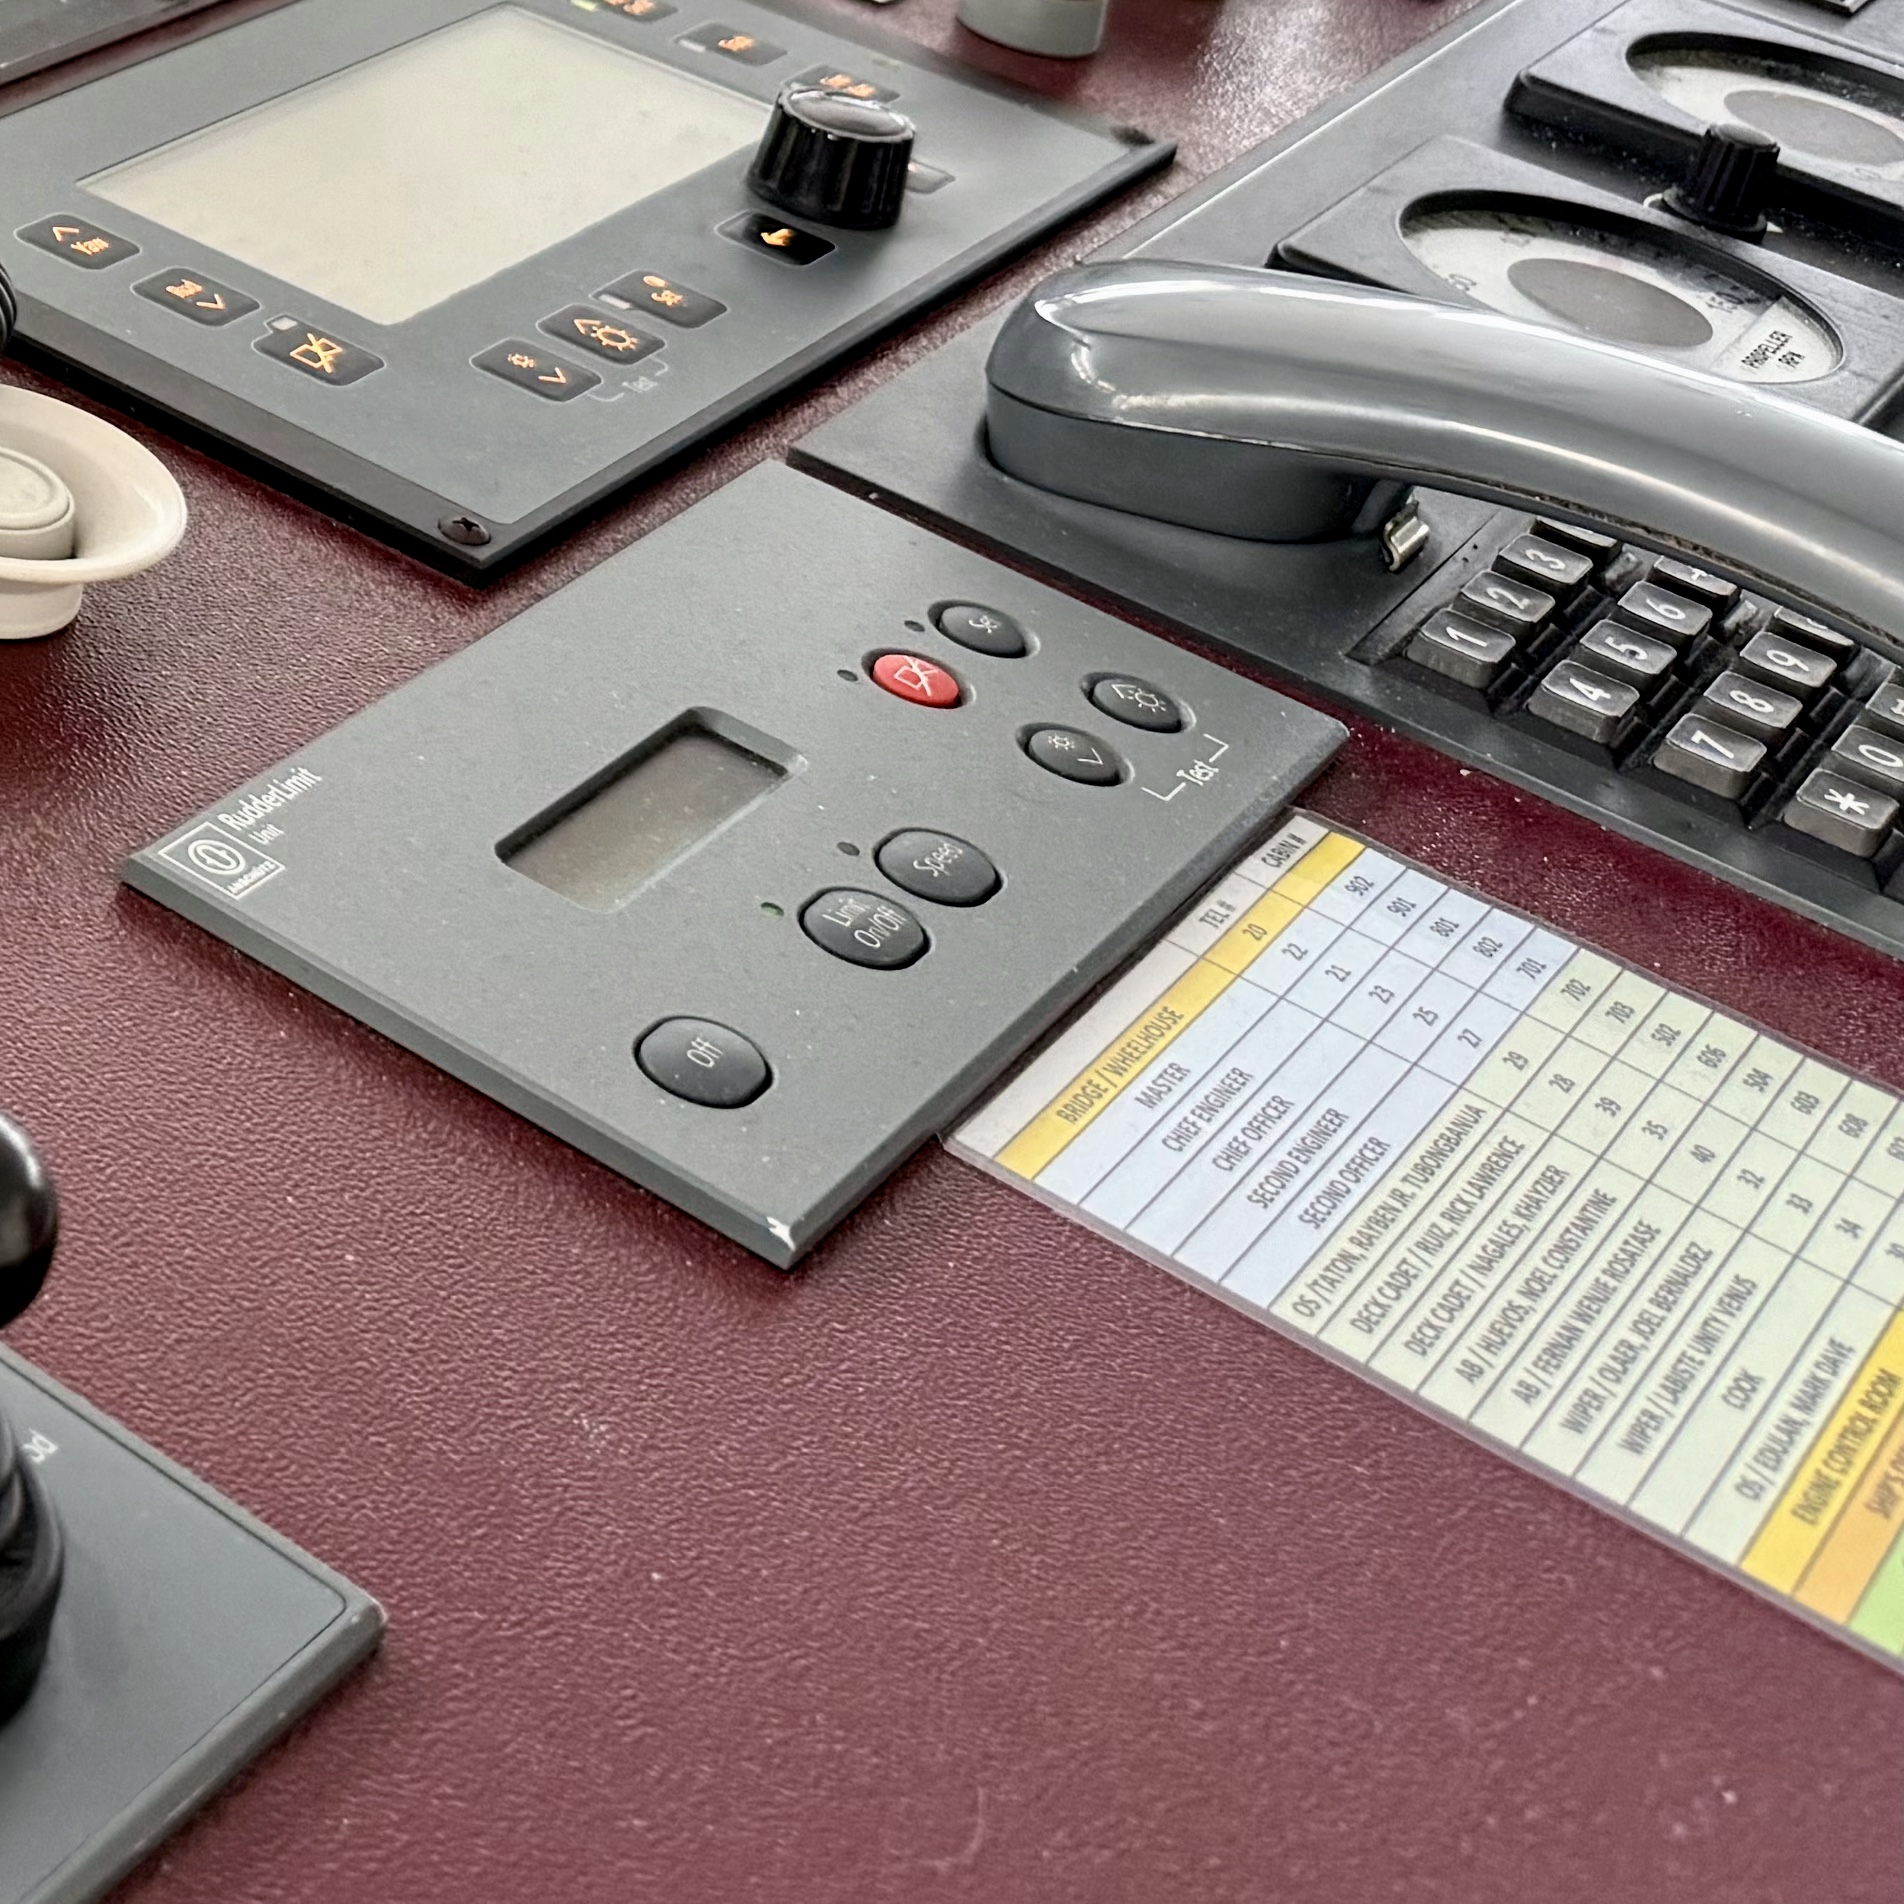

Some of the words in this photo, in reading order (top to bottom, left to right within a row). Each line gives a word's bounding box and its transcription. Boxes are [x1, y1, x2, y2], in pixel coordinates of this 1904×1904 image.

[1531, 547, 1567, 572] 3
[1485, 586, 1530, 611] 2
[1657, 598, 1687, 620] 6
[1445, 625, 1489, 647] 1
[1617, 637, 1649, 661] 5
[1767, 648, 1811, 672] 9
[1568, 676, 1612, 702] 4
[1729, 689, 1773, 714] 8
[1692, 730, 1736, 759] 7
[1857, 743, 1903, 767] 0
[1177, 760, 1219, 790] Test
[217, 779, 286, 831] Rudder
[249, 823, 284, 846] Unit
[928, 839, 966, 879] Speed
[1200, 907, 1225, 930] TEL
[1261, 839, 1296, 870] CABIN
[853, 905, 908, 952] On/Off
[1134, 1061, 1192, 1110] MASTER
[1282, 942, 1311, 962] 22
[1344, 874, 1376, 897] 902
[1558, 977, 1593, 1004] 702
[1056, 1070, 1100, 1126] BRIDGE
[1103, 1006, 1186, 1078] WHEELHOUSE
[1242, 923, 1269, 943] 20
[1160, 1109, 1204, 1154] CHIEF
[1195, 1066, 1256, 1121] ENGINEER
[1324, 963, 1352, 984] 21
[1386, 896, 1418, 918] 901
[1212, 1127, 1254, 1174] CHIEF
[1244, 1093, 1296, 1140] OFFICER
[1368, 984, 1397, 1006] 23
[1428, 917, 1461, 941] 801
[687, 1037, 724, 1069] Off
[1245, 1158, 1296, 1211] SECOND
[1289, 1106, 1351, 1168] ENGINEER
[1412, 1006, 1440, 1028] 25
[1470, 934, 1505, 960] 802
[1502, 1050, 1530, 1073] 29
[1296, 1179, 1347, 1232] SECOND
[1339, 1134, 1392, 1189] OFFICER
[1455, 1027, 1486, 1050] 27
[1514, 956, 1549, 981] 701
[1349, 1295, 1389, 1336] DECK
[1377, 1256, 1424, 1308] CADET
[1443, 1193, 1478, 1237] RICK
[1464, 1135, 1526, 1204] LAWRENCE
[1548, 1071, 1577, 1096] 28
[1604, 999, 1637, 1026] 703
[1401, 1104, 1487, 1197] TUBONGBANUA
[1389, 1180, 1416, 1214] JR.
[1404, 1318, 1442, 1359] DECK
[1430, 1283, 1473, 1329] CADET
[1594, 1096, 1623, 1120] 39
[1649, 1022, 1682, 1048] 502
[1350, 1199, 1397, 1253] RAYBEN
[1509, 1376, 1542, 1409] AB
[1536, 1314, 1586, 1377] FERNAN
[1688, 1142, 1718, 1167] 40
[1740, 1067, 1776, 1094] 504
[1454, 1353, 1485, 1386] AB
[1514, 1262, 1555, 1309] NOEL
[1539, 1186, 1620, 1278] CONSTANTINE
[1640, 1118, 1670, 1143] 35
[1290, 1289, 1319, 1319] OS
[1558, 1388, 1602, 1437] WIPER
[1628, 1309, 1659, 1352] JOEL
[1735, 1167, 1767, 1193] 32
[1617, 1408, 1665, 1458] WIPER
[1785, 1191, 1814, 1216] 33
[1721, 1367, 1766, 1412] COOK
[1834, 1217, 1864, 1243] 34
[1860, 1367, 1903, 1420] ROOM
[1733, 1473, 1768, 1504] OS
[1795, 1376, 1831, 1419] MARK
